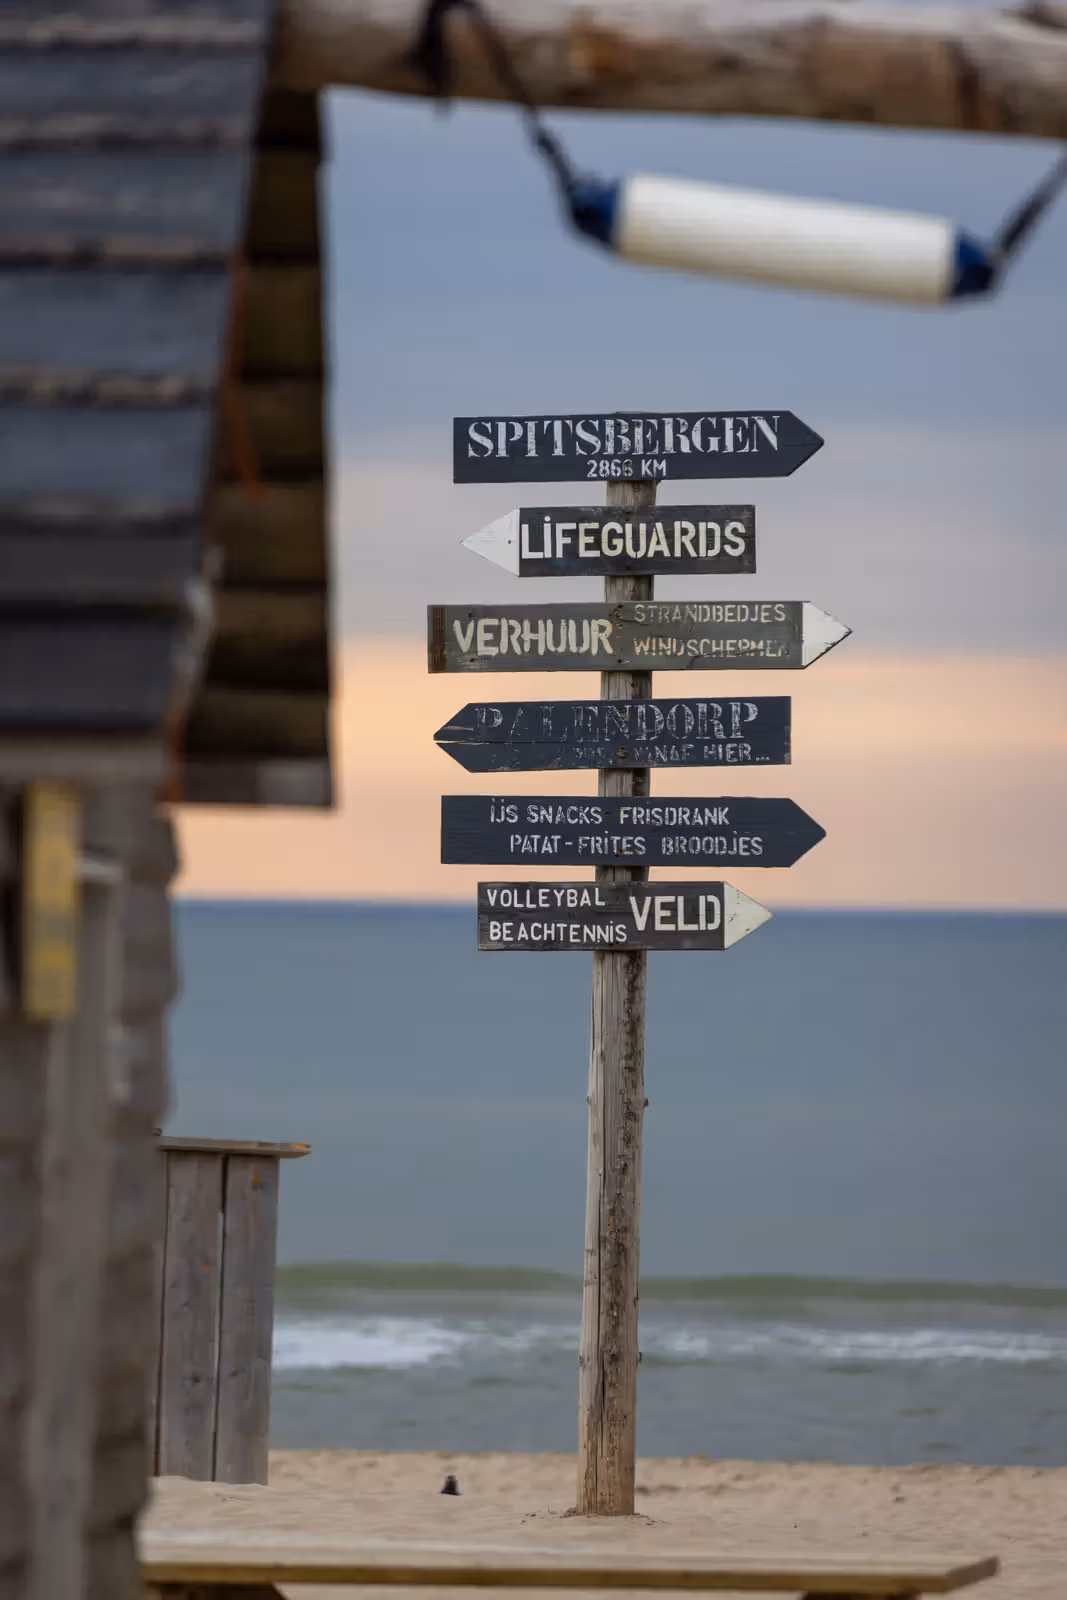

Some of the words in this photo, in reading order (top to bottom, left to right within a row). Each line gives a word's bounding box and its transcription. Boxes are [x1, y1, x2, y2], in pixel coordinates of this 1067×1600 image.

[467, 415, 780, 458] SPITSBERGEN
[641, 459, 667, 477] KM
[634, 603, 787, 624] STRANDBEDJES
[453, 617, 614, 656] VERHUUR
[527, 805, 602, 824] SNACKS
[619, 807, 730, 825] FRISDRANK
[487, 888, 606, 908] VOLLEYBAL
[630, 895, 721, 931] VELD
[489, 920, 628, 943] BEACHTENNIS
